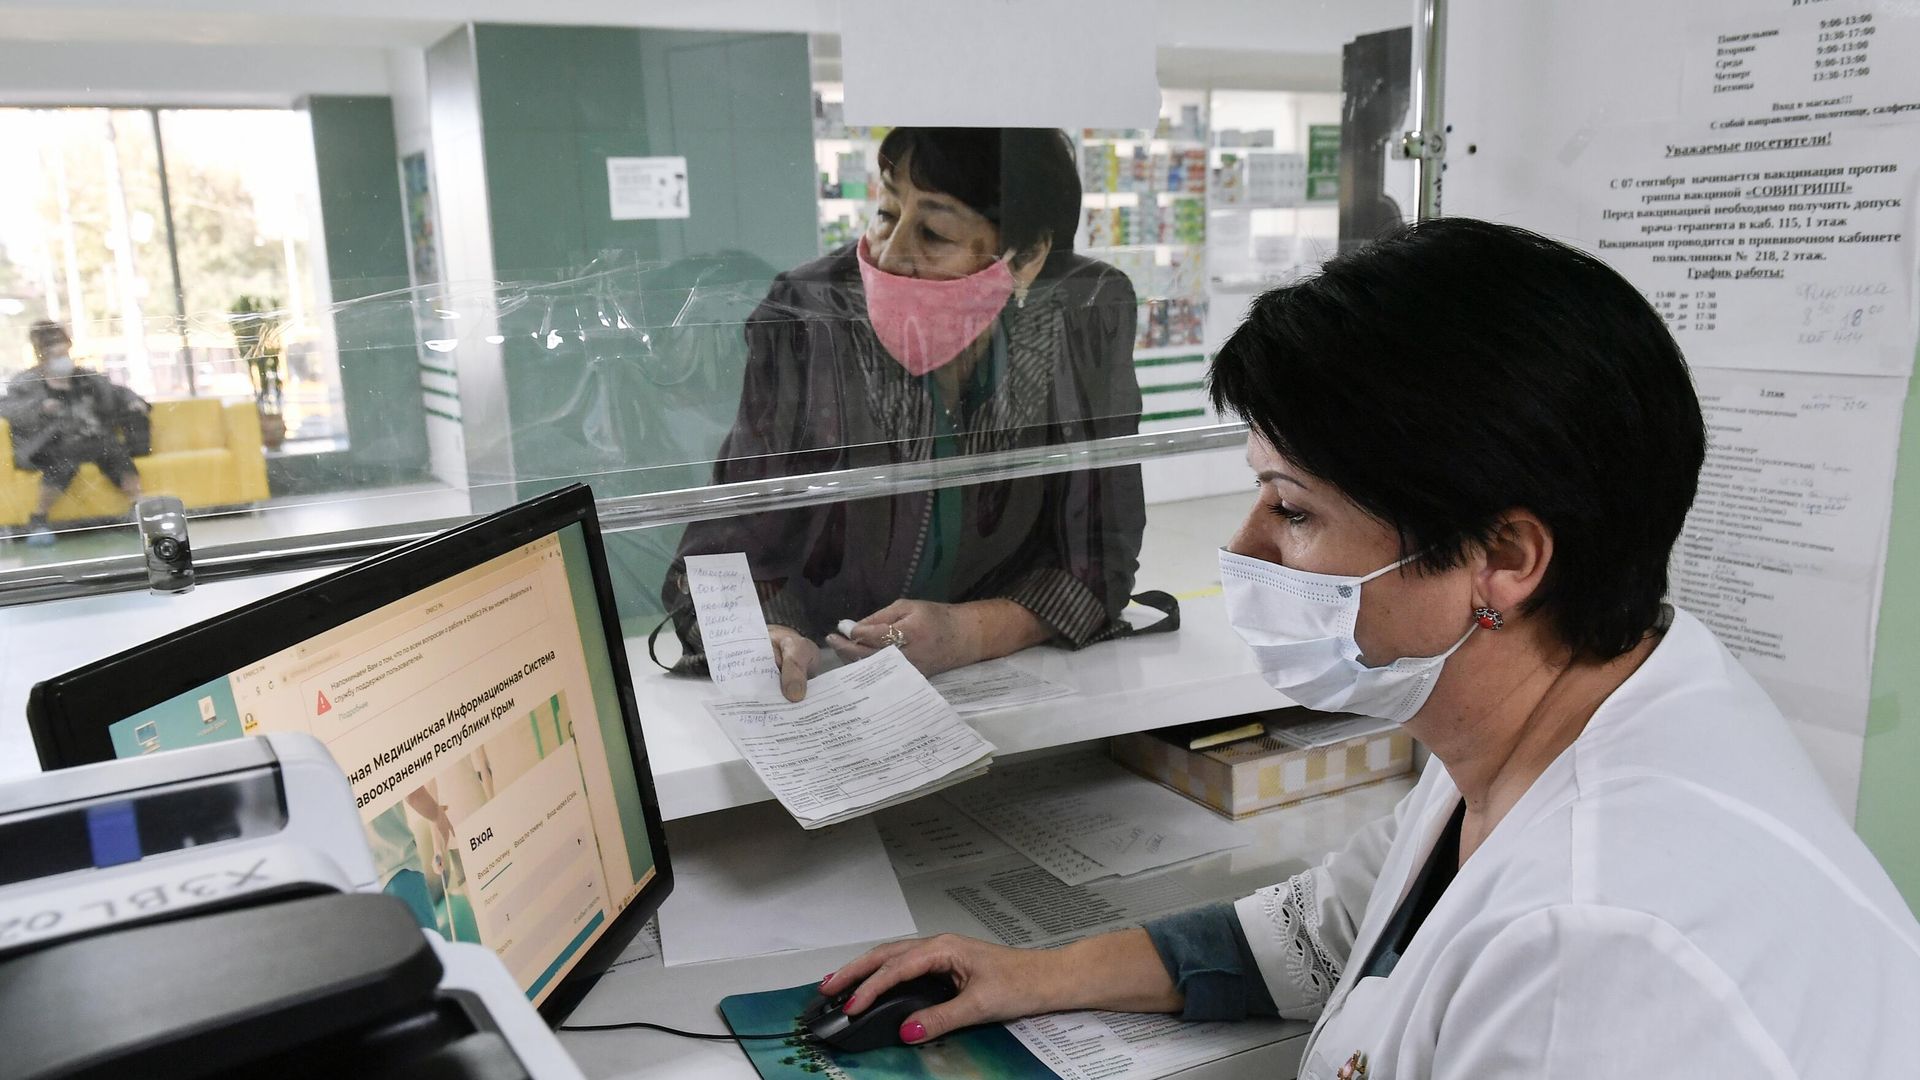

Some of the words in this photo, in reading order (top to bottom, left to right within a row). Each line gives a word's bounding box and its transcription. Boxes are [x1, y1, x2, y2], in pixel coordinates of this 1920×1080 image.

[1715, 58, 1744, 70] Среда
[1665, 141, 1741, 157] Уважаемые
[1744, 132, 1832, 150] посетители!
[1621, 178, 1633, 188] 07
[1636, 175, 1686, 188] сентября
[1691, 172, 1760, 184] начинается
[1764, 166, 1844, 181] вакцинация
[1848, 163, 1898, 178] против
[1641, 193, 1681, 205] гриппа
[1684, 187, 1741, 201] вакциной
[1602, 209, 1634, 222] Перед
[1636, 204, 1711, 219] вакцинацией
[1714, 202, 1784, 215] необходимо
[1788, 199, 1851, 213] получить
[1853, 198, 1902, 212] допуск
[1738, 222, 1746, 230] в
[1750, 218, 1774, 229] каб.
[1779, 217, 1801, 229] 115,
[1806, 217, 1812, 228] 1
[1817, 217, 1847, 227] этаж
[1598, 239, 1665, 249] Вакцинация
[1667, 238, 1735, 249] проводится
[1749, 234, 1835, 248] прививочном
[1838, 231, 1901, 243] кабинете
[1652, 253, 1732, 263] поликлиники
[1755, 251, 1779, 262] 218,
[1782, 251, 1790, 261] 2
[1793, 252, 1827, 261] этаж.
[1687, 267, 1732, 280] График
[330, 667, 367, 690] Напоминаем
[367, 662, 378, 673] Вам
[393, 650, 403, 659] что
[402, 646, 410, 654] по
[410, 640, 421, 651] всем
[422, 629, 444, 645] вопросам
[448, 619, 463, 632] работе
[334, 687, 354, 703] службу
[355, 671, 385, 693] поддержки
[338, 701, 369, 721] Подробнее
[347, 764, 372, 786] ная
[373, 717, 446, 771] Медицинская
[446, 670, 524, 726] Информационная
[523, 650, 556, 676] Система
[434, 711, 491, 758] Республики
[490, 696, 516, 721] Крым
[546, 808, 557, 820] Вход
[469, 827, 494, 852] Вход
[514, 836, 525, 849] Вход
[477, 867, 490, 880] Вход
[495, 849, 511, 863] логину
